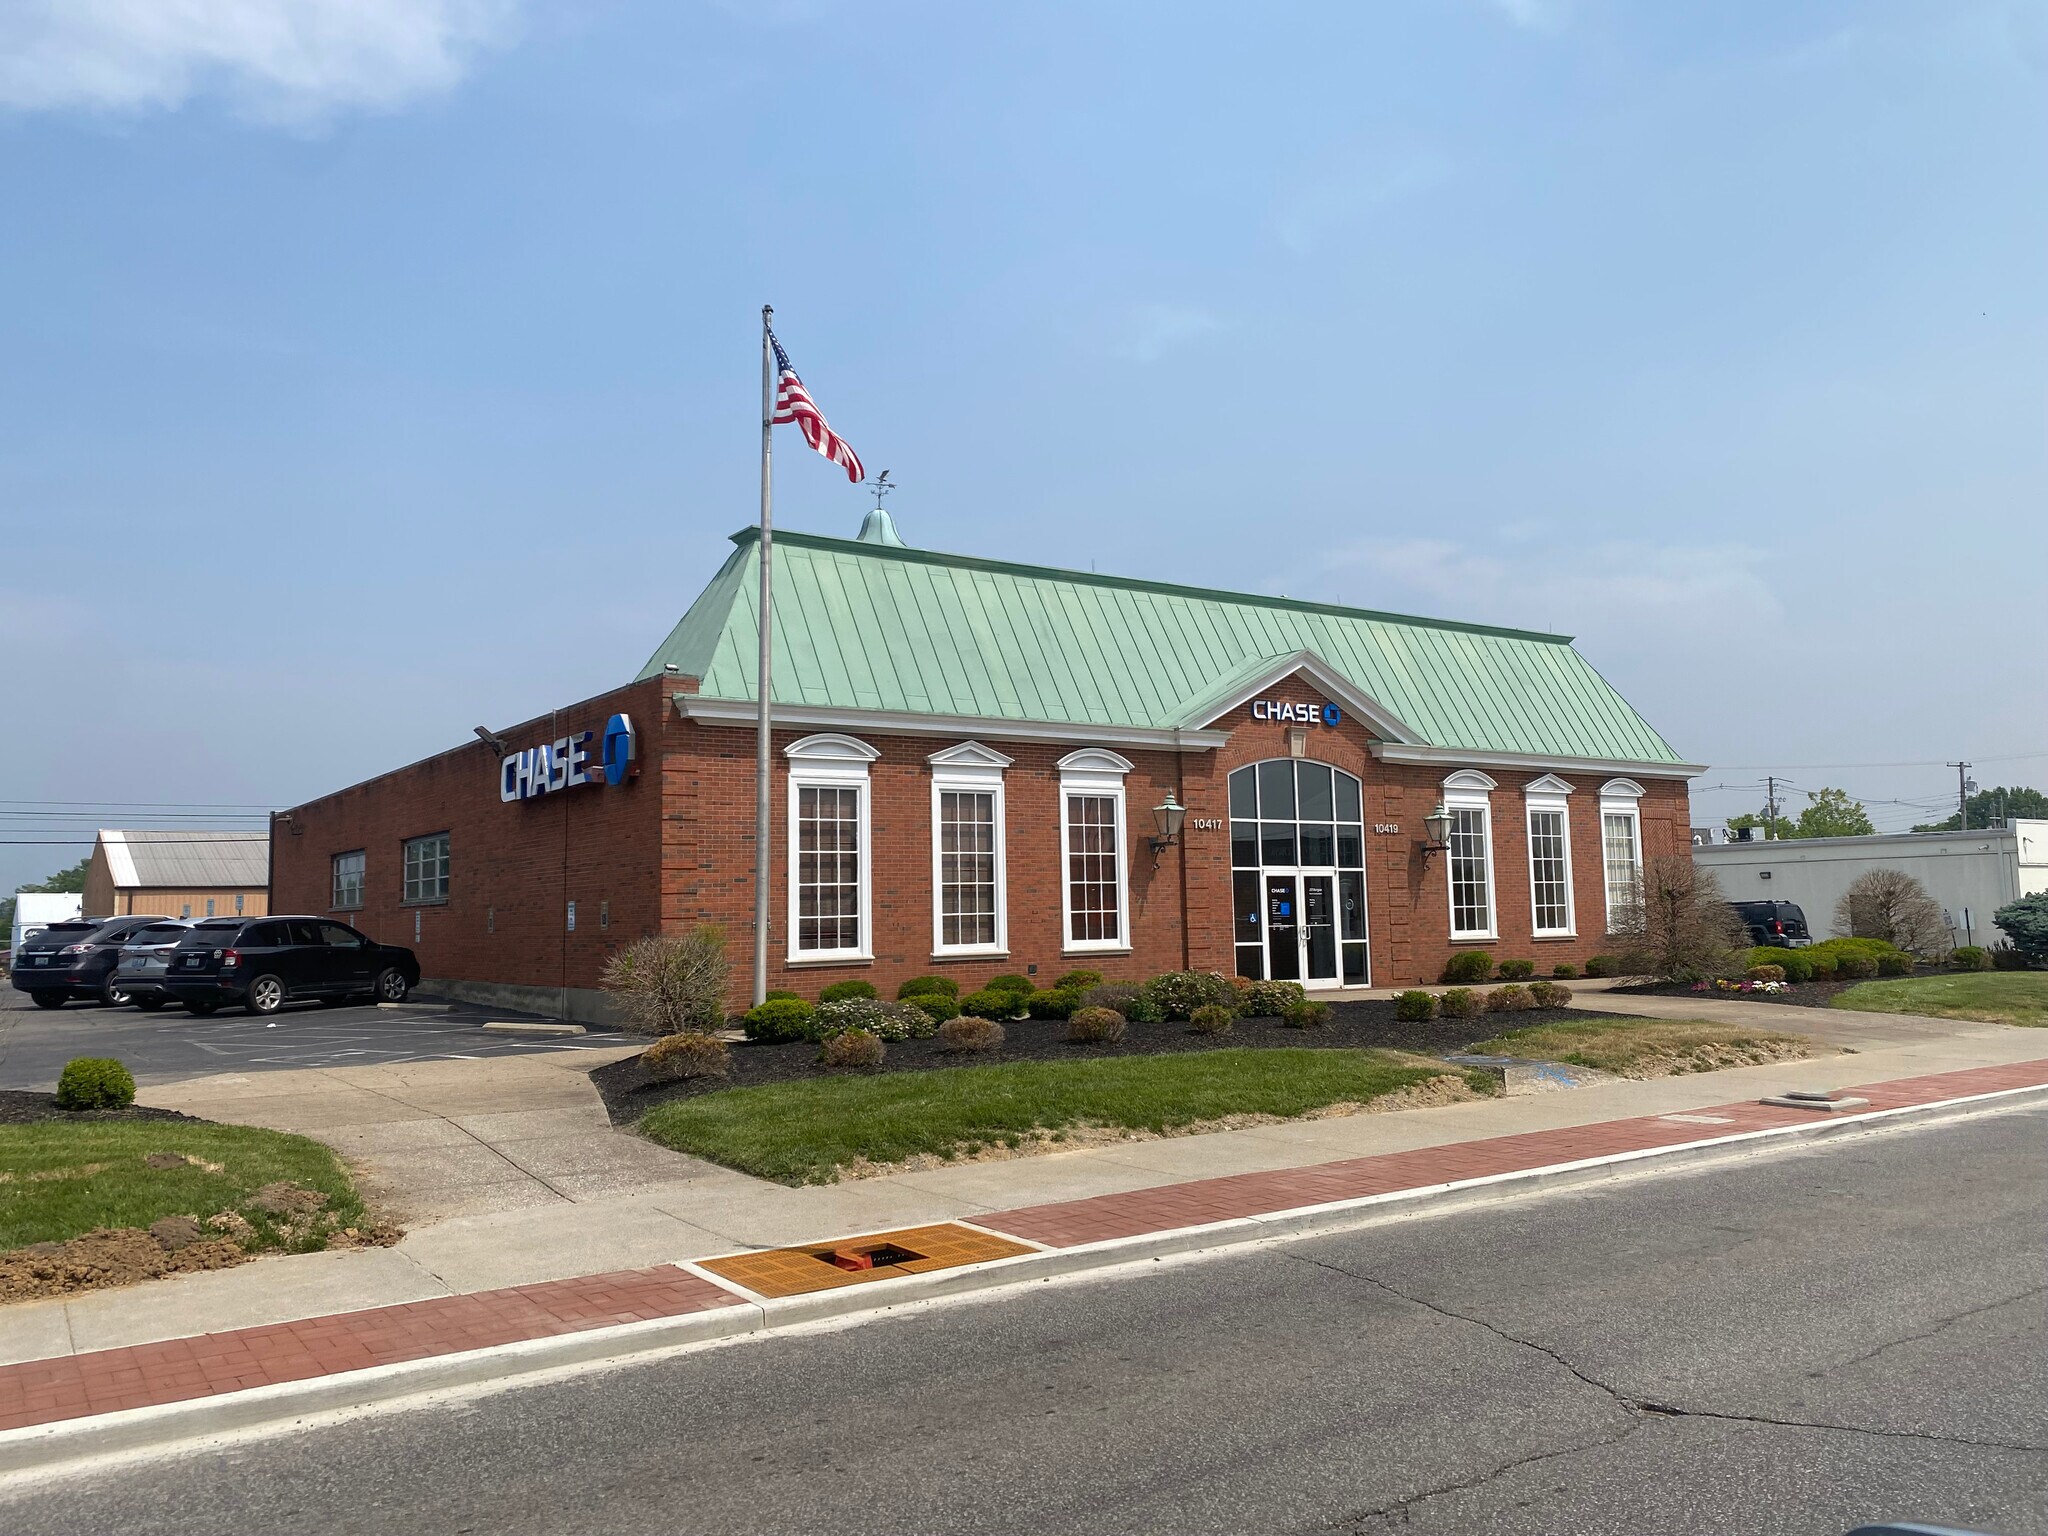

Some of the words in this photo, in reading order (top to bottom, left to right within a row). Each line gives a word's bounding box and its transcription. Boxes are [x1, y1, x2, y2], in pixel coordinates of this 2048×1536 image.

[1253, 700, 1321, 723] CHASE
[501, 730, 593, 803] CHASE
[1193, 818, 1223, 830] 10417
[1374, 823, 1399, 834] 10419
